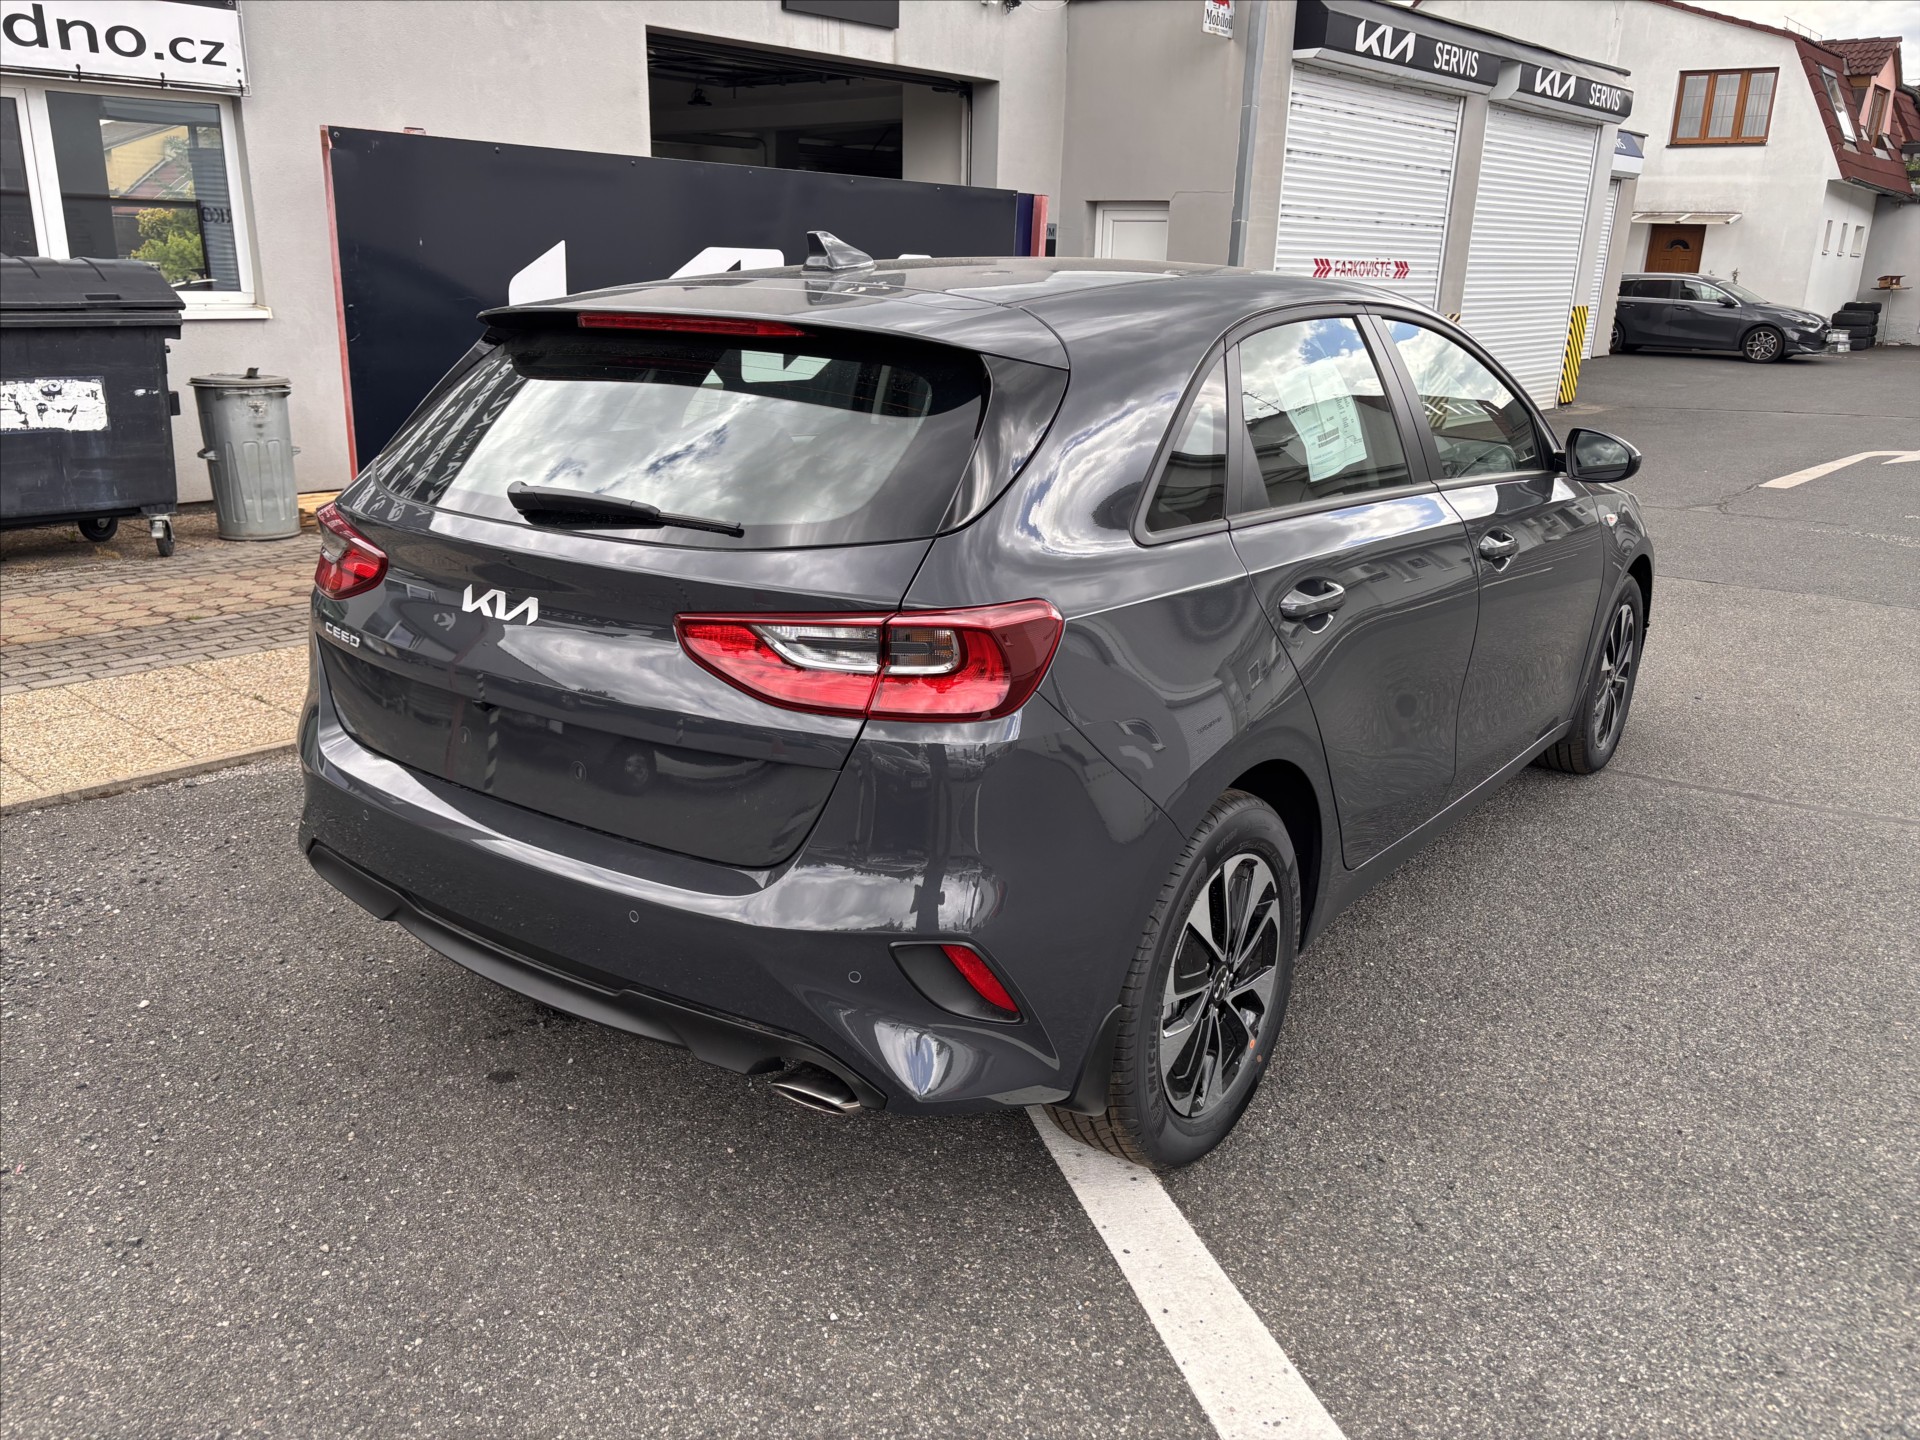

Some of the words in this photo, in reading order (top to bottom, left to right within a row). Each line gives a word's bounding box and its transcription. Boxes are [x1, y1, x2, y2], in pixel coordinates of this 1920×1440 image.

[2, 3, 227, 67] dno.cz
[1205, 9, 1233, 30] Mobiloil
[1355, 19, 1416, 64] KIA
[1434, 41, 1479, 78] SERVIS
[1534, 67, 1577, 100] KIA
[1589, 82, 1621, 111] SERVIS
[462, 584, 539, 626] KIA
[325, 621, 361, 649] CEED
